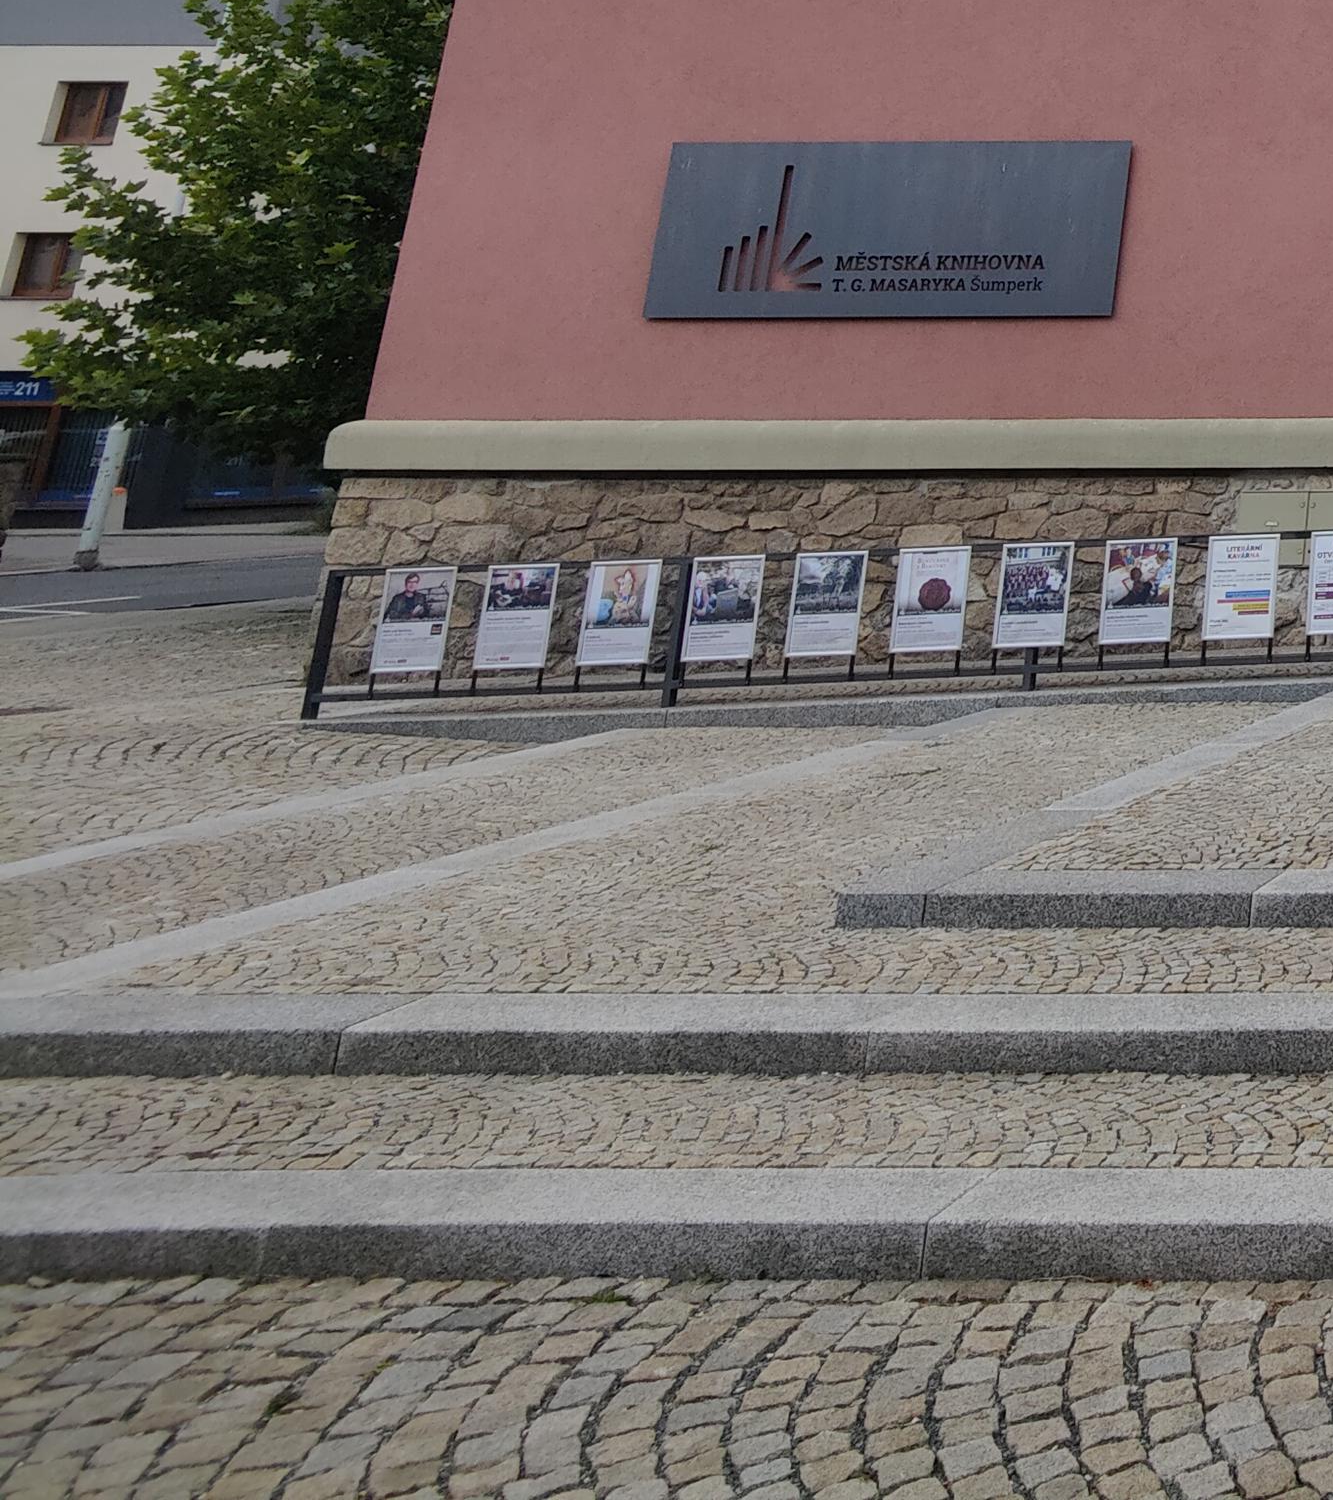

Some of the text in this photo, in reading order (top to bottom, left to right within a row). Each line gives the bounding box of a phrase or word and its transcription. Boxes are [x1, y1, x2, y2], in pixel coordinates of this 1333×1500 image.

[834, 251, 1046, 271] MĚSTSKÁ KNIHOVNA
[832, 274, 1044, 295] T. G. MASARYKA Šumperk
[14, 381, 41, 396] 211
